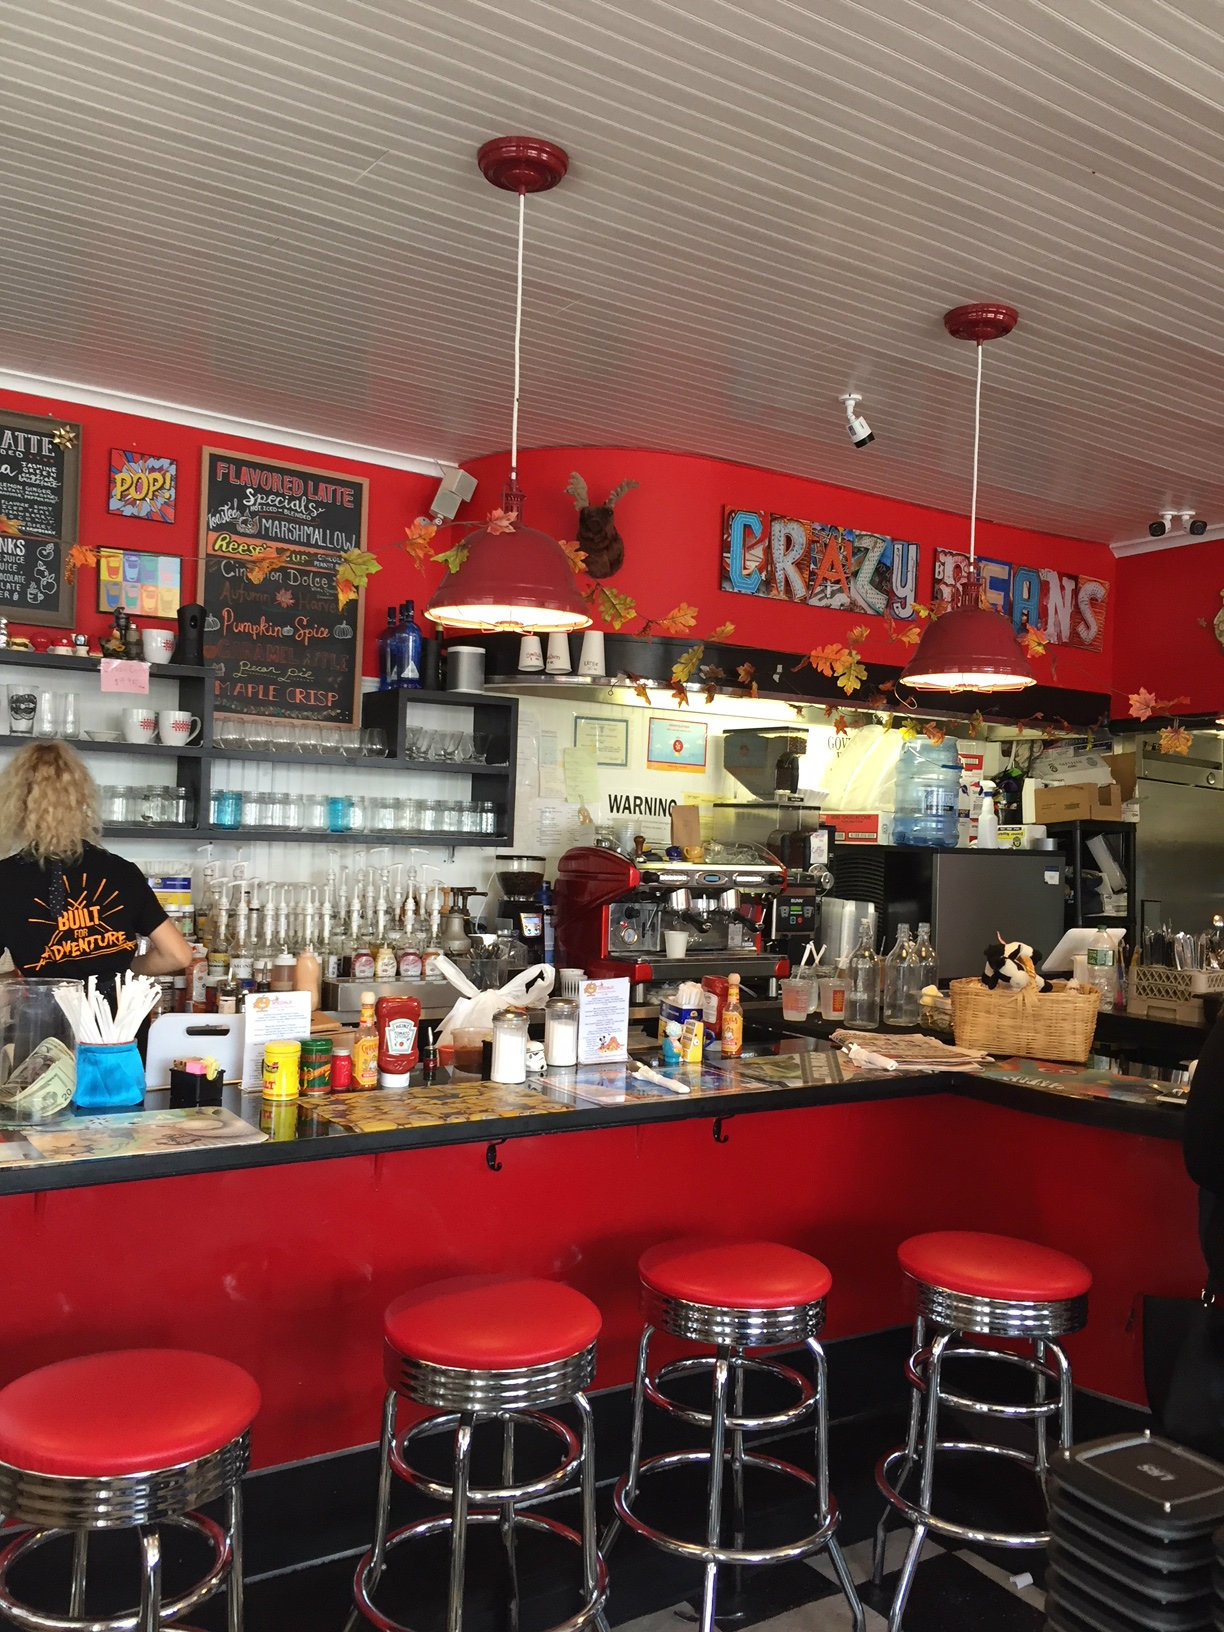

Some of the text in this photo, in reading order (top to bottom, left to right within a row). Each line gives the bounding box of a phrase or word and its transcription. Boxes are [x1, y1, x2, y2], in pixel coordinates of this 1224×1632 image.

[0, 430, 56, 456] ATTE
[114, 472, 172, 501] POP!
[216, 461, 355, 509] FLAVORED LATTE
[208, 498, 240, 530] Toasted
[243, 488, 319, 517] Specials
[0, 538, 26, 556] NKS
[213, 532, 269, 556] Reese'
[261, 518, 356, 551] MARSHMALLOW
[0, 563, 18, 572] UICE
[220, 559, 329, 588] Cinon Dolce
[221, 607, 331, 646] Pumpkin Spice
[214, 680, 339, 707] MAPLE CRISP
[57, 906, 101, 931] BUILT
[41, 931, 127, 960] ADVENTURE
[74, 929, 89, 939] FOR
